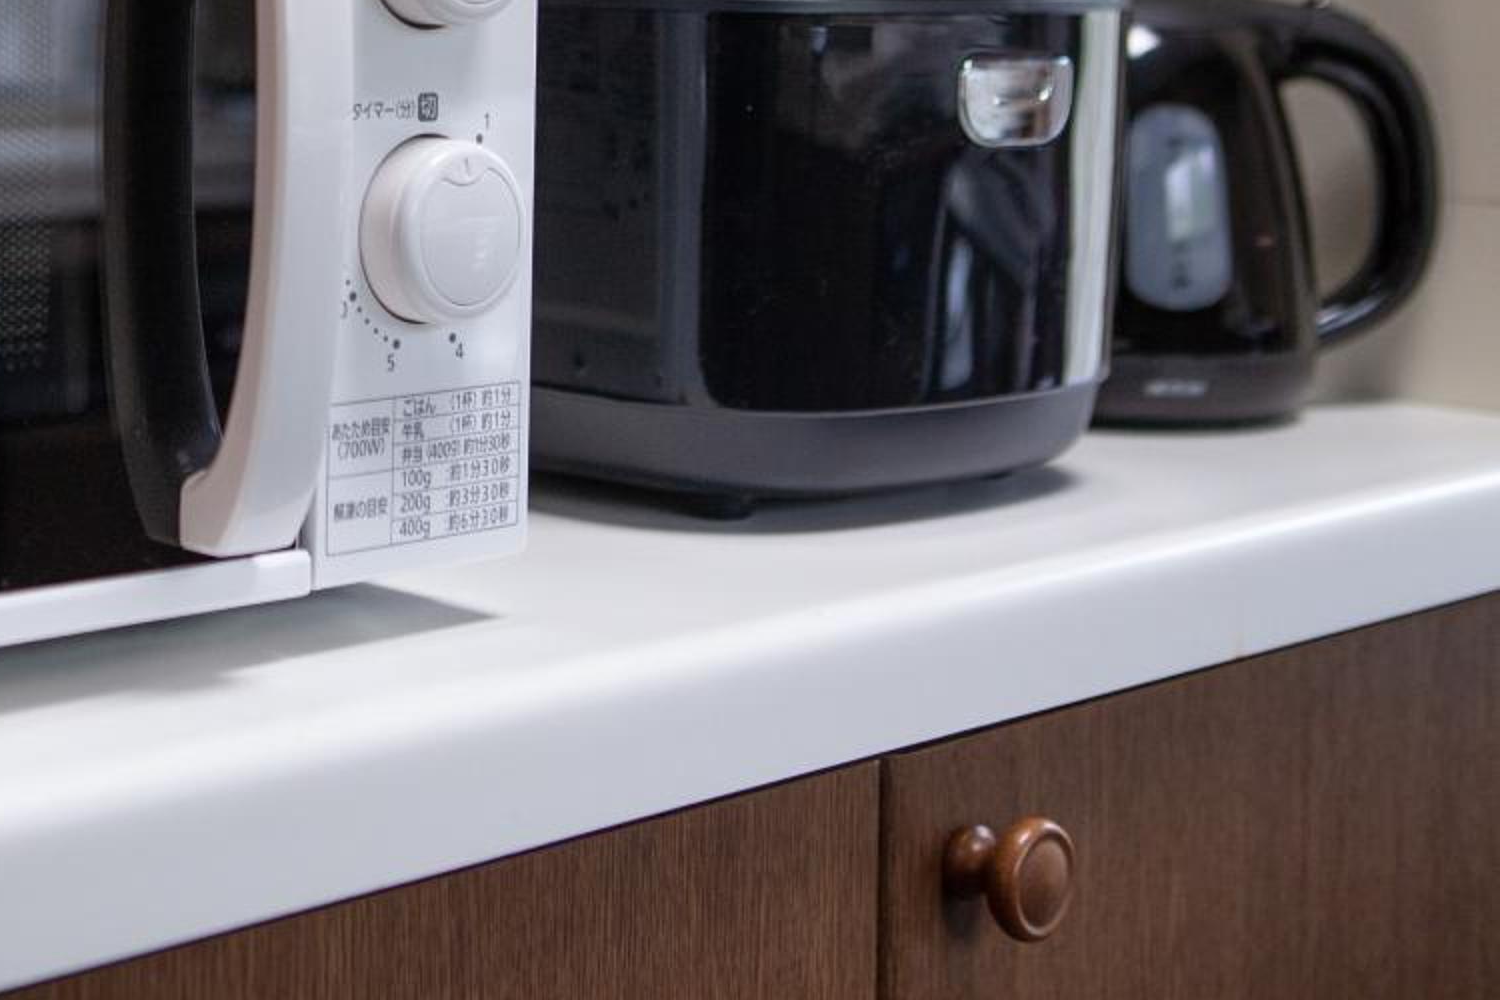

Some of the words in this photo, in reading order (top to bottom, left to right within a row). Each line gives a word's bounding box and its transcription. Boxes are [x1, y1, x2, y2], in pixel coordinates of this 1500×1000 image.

[386, 353, 395, 372] 5
[402, 469, 431, 488] 100g
[401, 494, 431, 514] 200g
[400, 519, 430, 540] 400g
